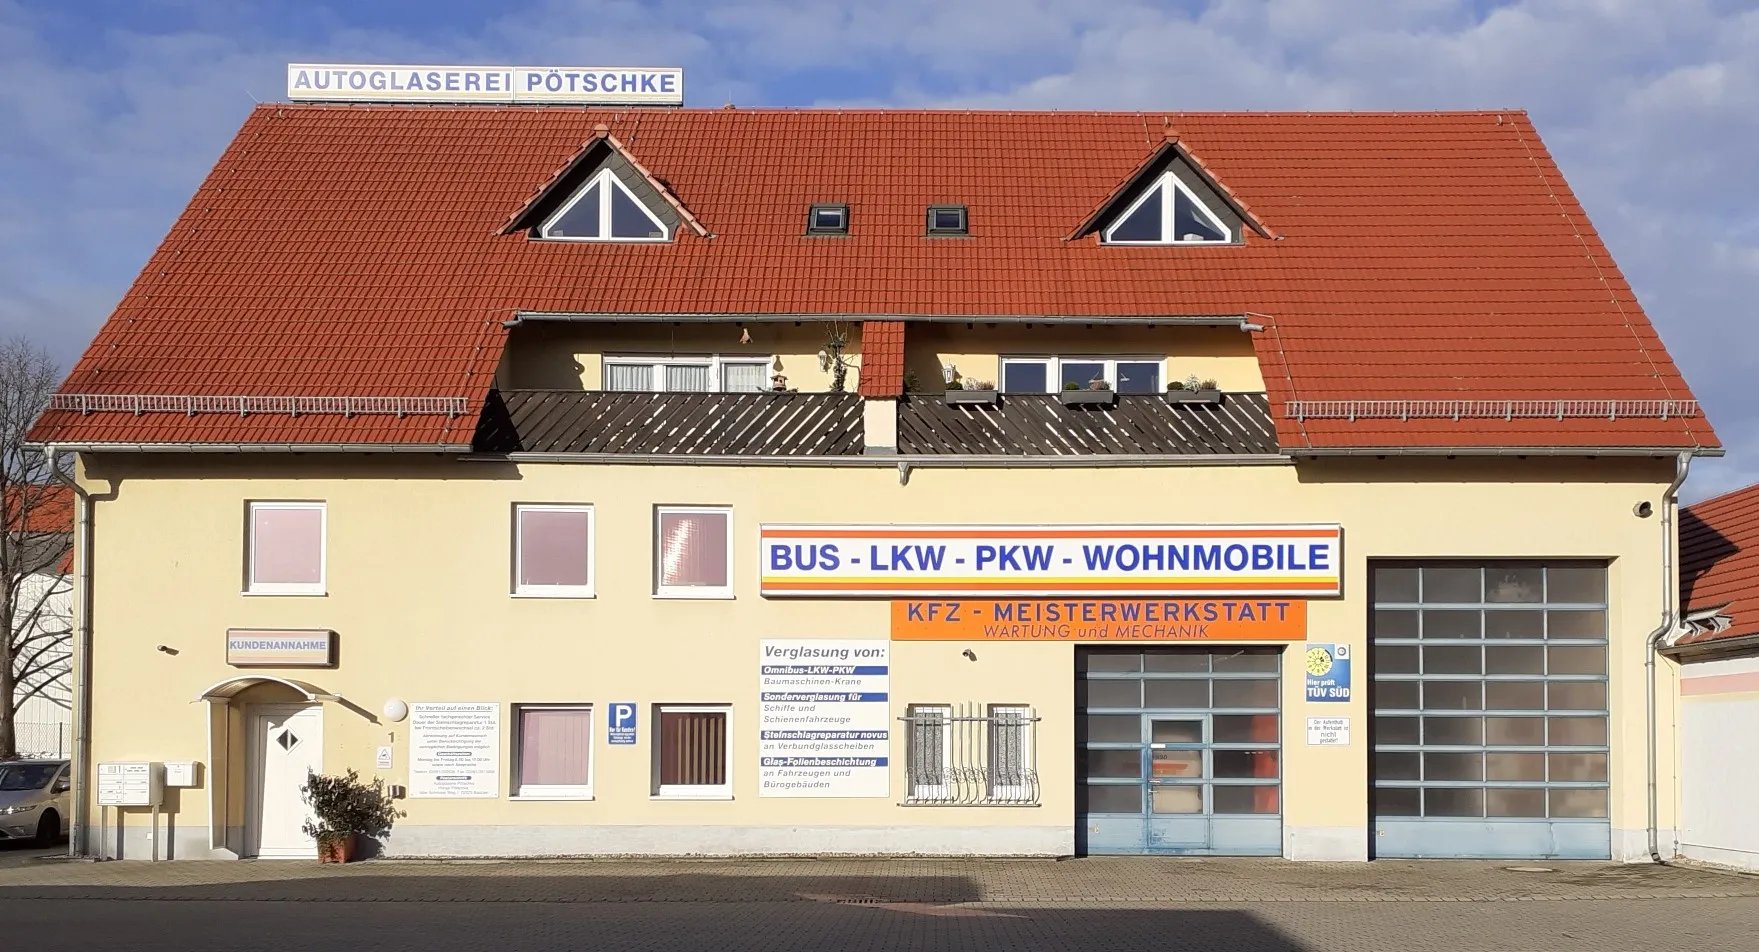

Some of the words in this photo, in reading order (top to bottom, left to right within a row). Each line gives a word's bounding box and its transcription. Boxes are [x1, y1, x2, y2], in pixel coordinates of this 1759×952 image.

[294, 70, 511, 92] AUTOGLASEREI
[527, 69, 675, 93] PÖTSCHKE
[770, 544, 840, 571] BUS
[870, 545, 946, 571] LKW
[976, 545, 1054, 571] PKW
[1082, 544, 1330, 571] WOHNMOBILE
[907, 602, 961, 622] KFZ
[994, 602, 1290, 622] MEISTERWERKSTATT
[984, 624, 1070, 638] WARTUNG
[1078, 624, 1108, 638] und
[1115, 624, 1209, 638] MECHANIK
[229, 640, 327, 650] KUNDENANNAHME
[765, 645, 849, 660] Verglasung
[854, 648, 885, 658] von:
[763, 666, 856, 674] Omnibus-LKW-PKW
[1320, 679, 1335, 687] prüft
[1307, 685, 1327, 698] TÜV
[1329, 685, 1350, 698] SÜD
[763, 693, 846, 702] Sonderverglasung
[848, 693, 862, 701] für
[763, 704, 795, 712] Schiffe
[798, 704, 816, 712] und
[616, 704, 632, 727] P
[763, 715, 851, 724] Schienenfahrzeuge
[387, 731, 395, 743] 1
[763, 731, 859, 740] Steinschlagreparatur
[778, 742, 875, 751] Verbundglasscheiben
[763, 757, 877, 767] Glas-Folienbeschichtung
[777, 769, 831, 778] Fahrzeugen
[833, 769, 851, 777] und
[763, 780, 830, 790] Bürogebäuden
